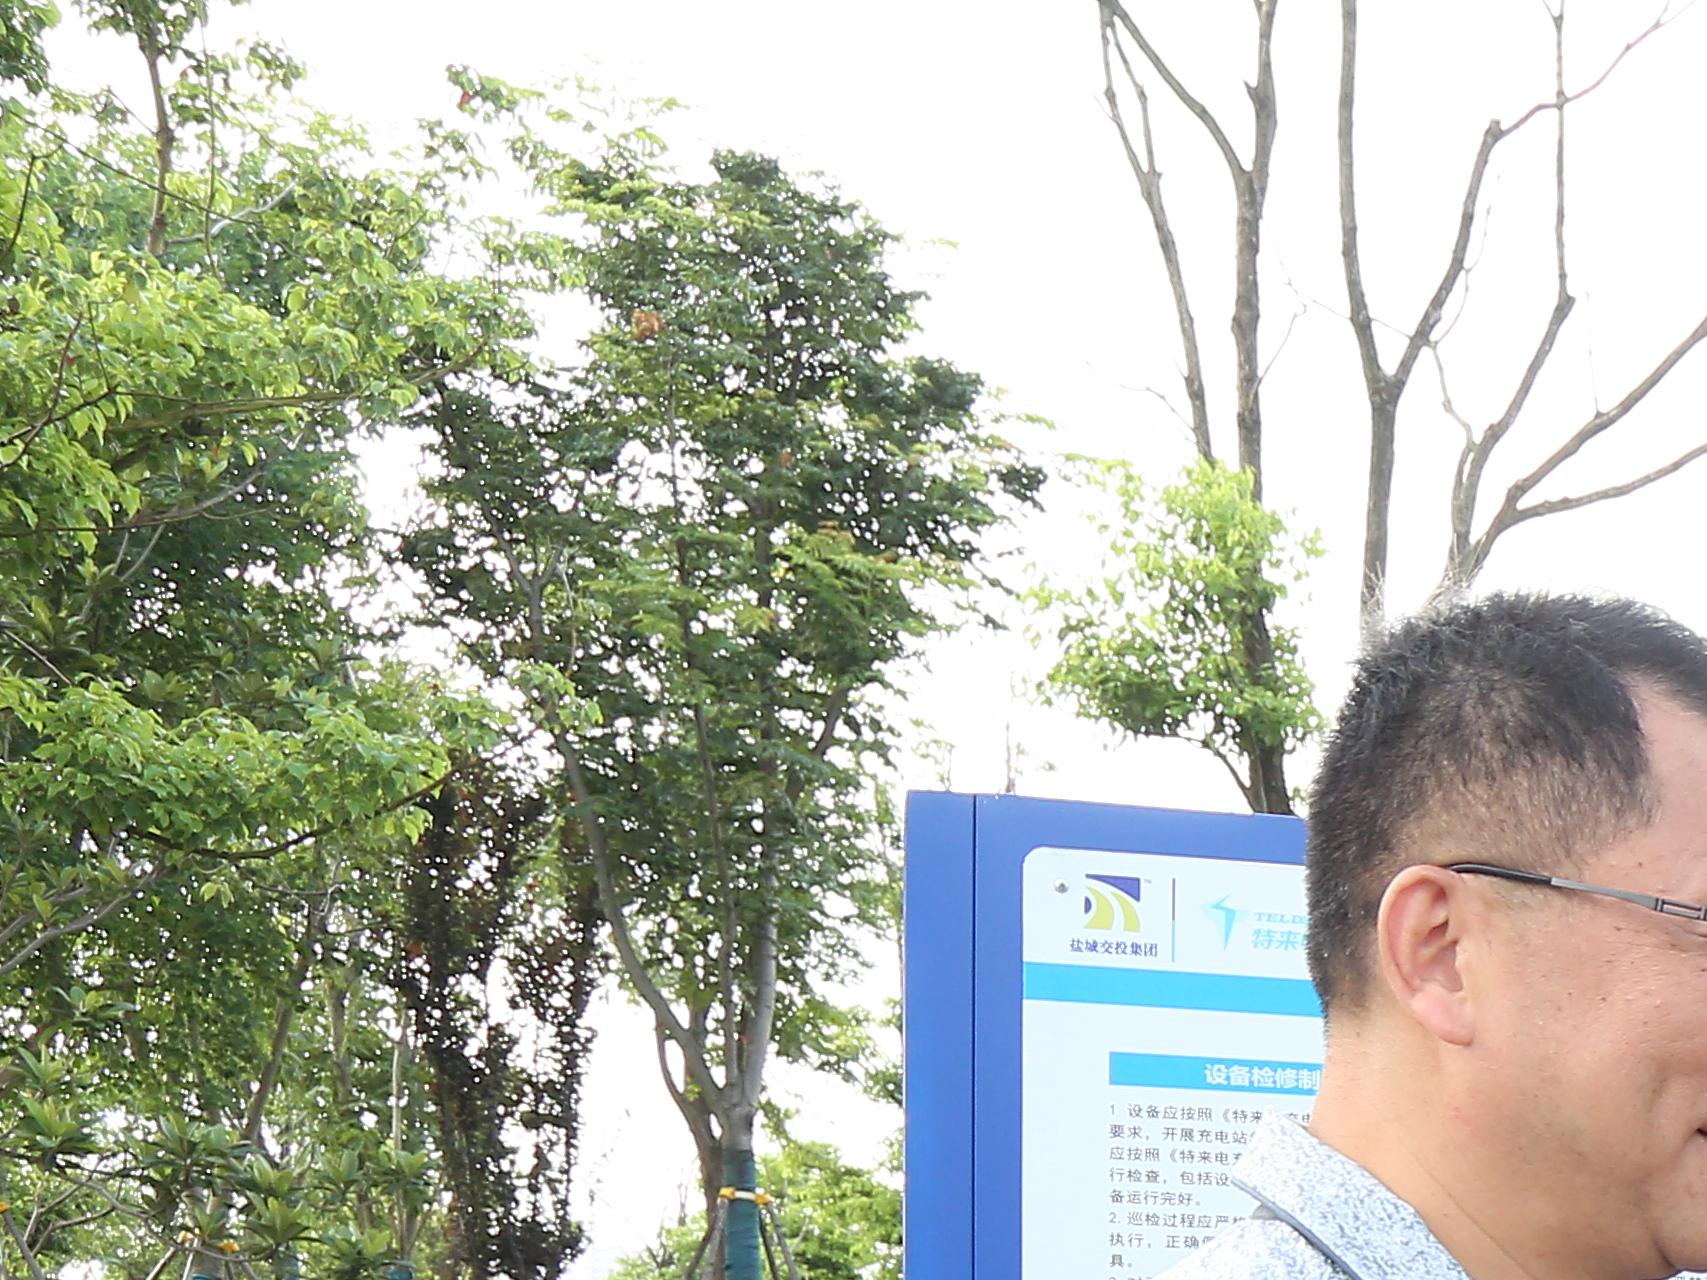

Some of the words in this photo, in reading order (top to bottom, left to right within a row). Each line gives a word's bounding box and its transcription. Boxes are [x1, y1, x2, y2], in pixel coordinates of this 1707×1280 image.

[1069, 938, 1158, 958] 盐城交投集团
[1204, 1062, 1321, 1091] 设备检修制
[1108, 1124, 1256, 1144] 要求，开展充电站
